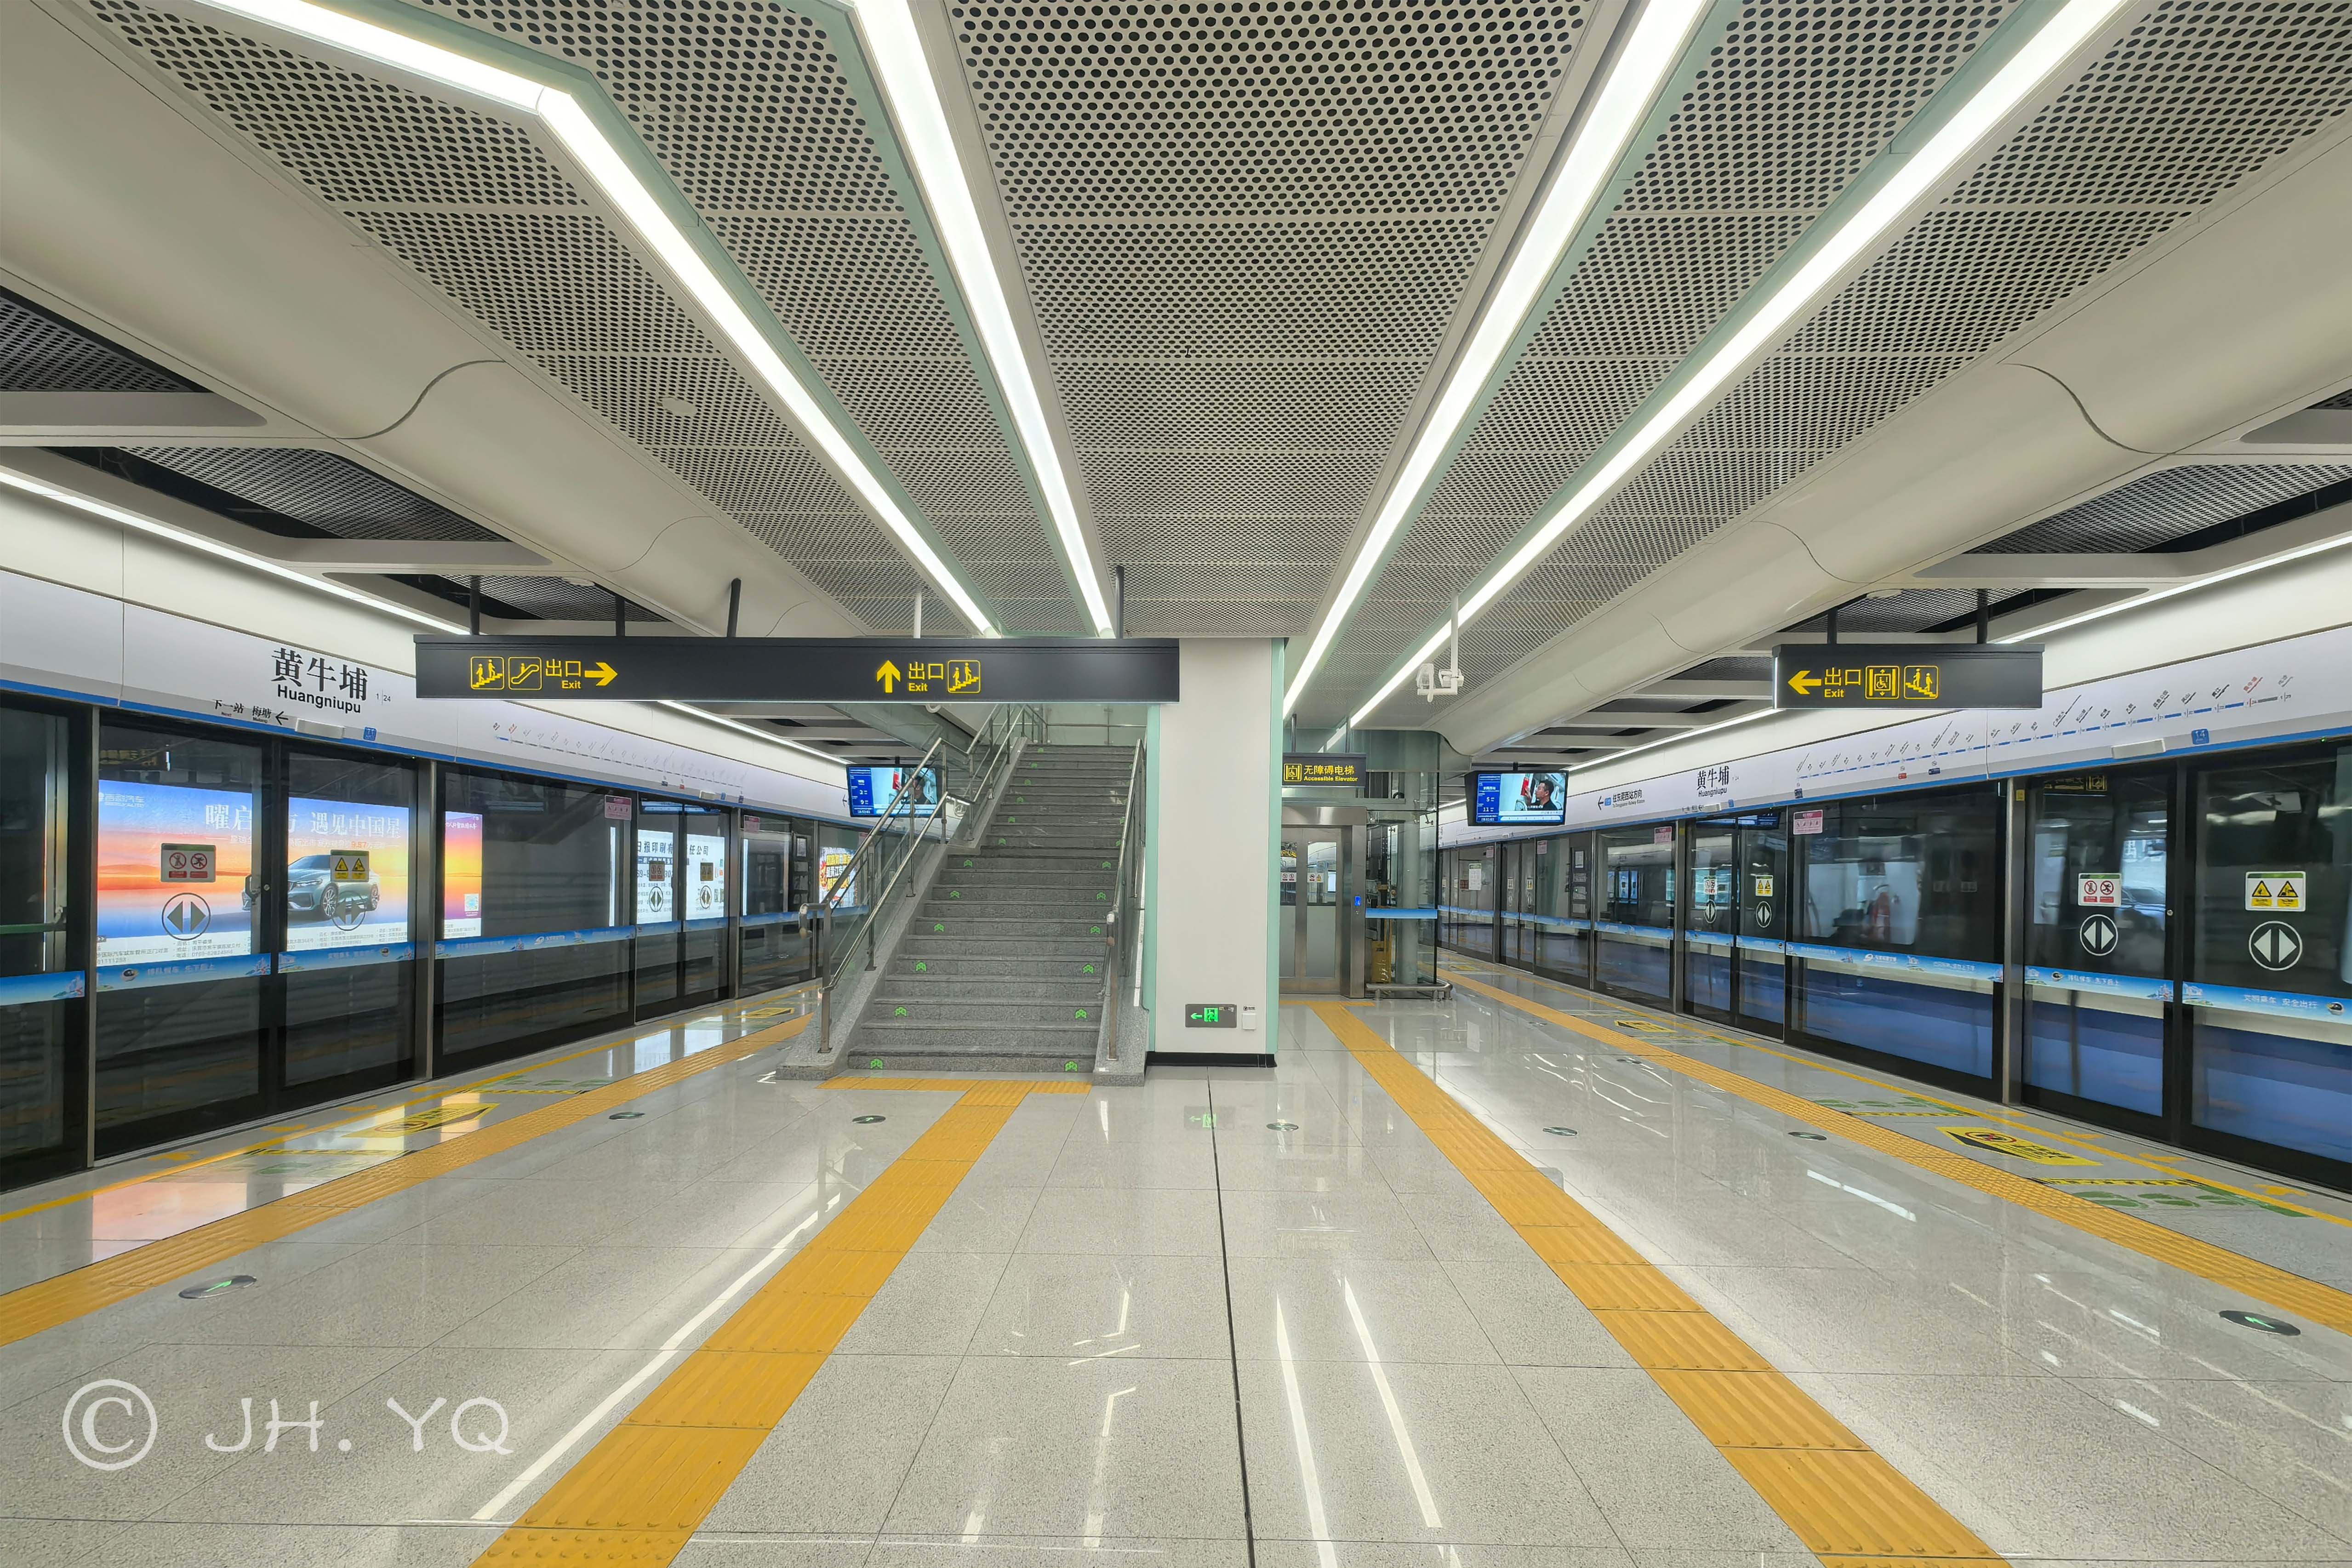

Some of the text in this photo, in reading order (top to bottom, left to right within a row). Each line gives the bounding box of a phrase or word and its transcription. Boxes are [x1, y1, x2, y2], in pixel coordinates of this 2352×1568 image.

[270, 647, 368, 701] 黄牛埔
[545, 659, 582, 677] 出口
[908, 661, 944, 680] 出口
[561, 680, 581, 689] Exit
[1824, 667, 1861, 686] 出口
[908, 683, 928, 692] Exit
[1824, 689, 1844, 698] Exit
[212, 699, 244, 713] 下一站
[278, 684, 361, 714] Huangniupu
[1303, 764, 1354, 775] 无障碍电梯
[1696, 765, 1730, 791] 黄牛埔
[1698, 787, 1727, 798] Huangniupu
[310, 811, 401, 839] 遇见中国星
[690, 844, 709, 856] 任公司
